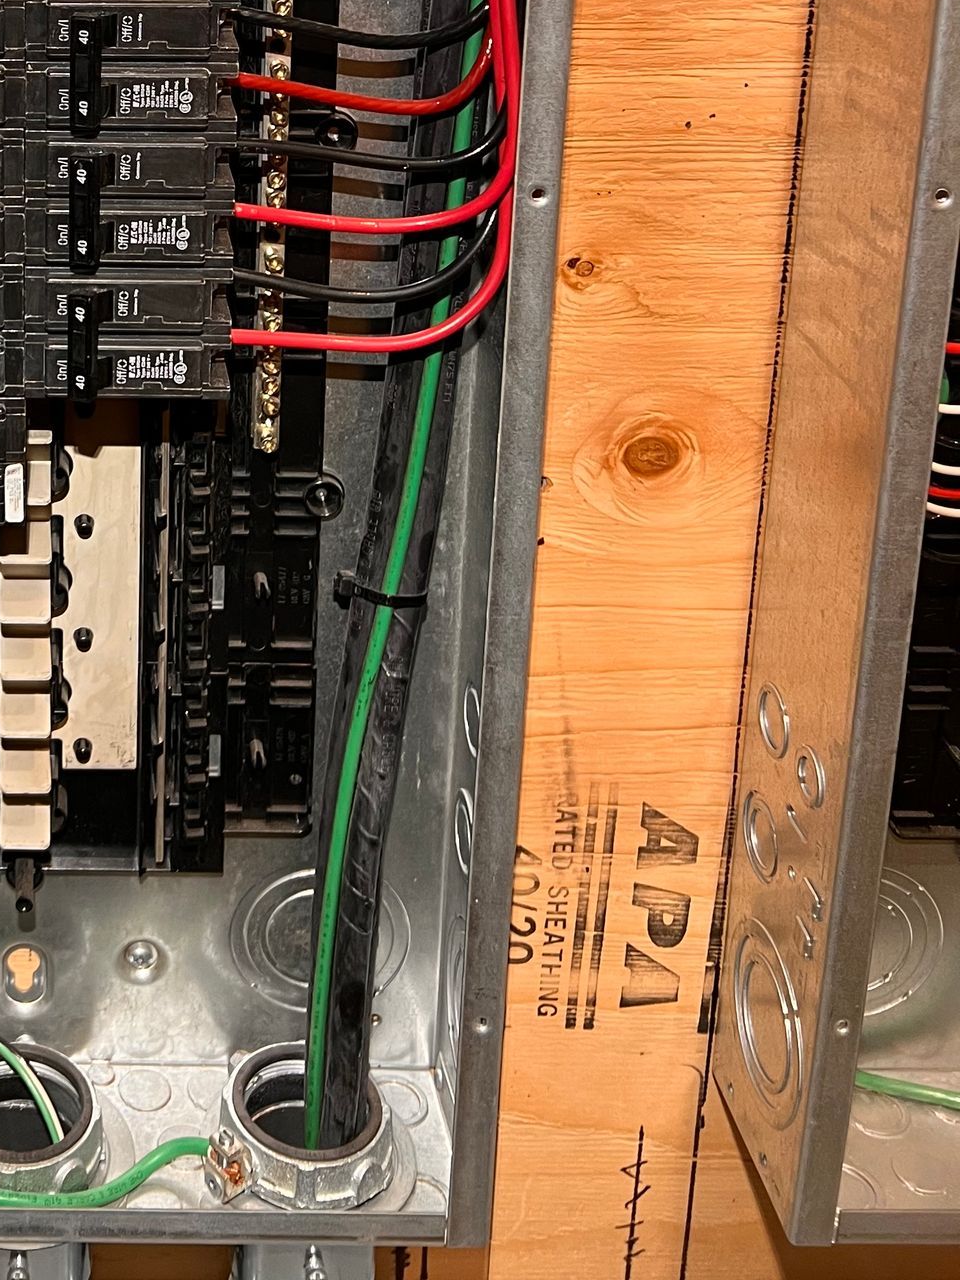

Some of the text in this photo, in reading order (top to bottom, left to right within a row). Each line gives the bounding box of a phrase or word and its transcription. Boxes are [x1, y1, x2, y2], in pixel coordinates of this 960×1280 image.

[79, 30, 89, 45] 40
[79, 101, 88, 116] 40
[76, 169, 87, 184] 40
[77, 240, 87, 255] 40
[75, 307, 85, 322] 40
[75, 375, 85, 390] 40
[537, 791, 579, 1017] RATED SHEATHING
[619, 801, 699, 1008] APA
